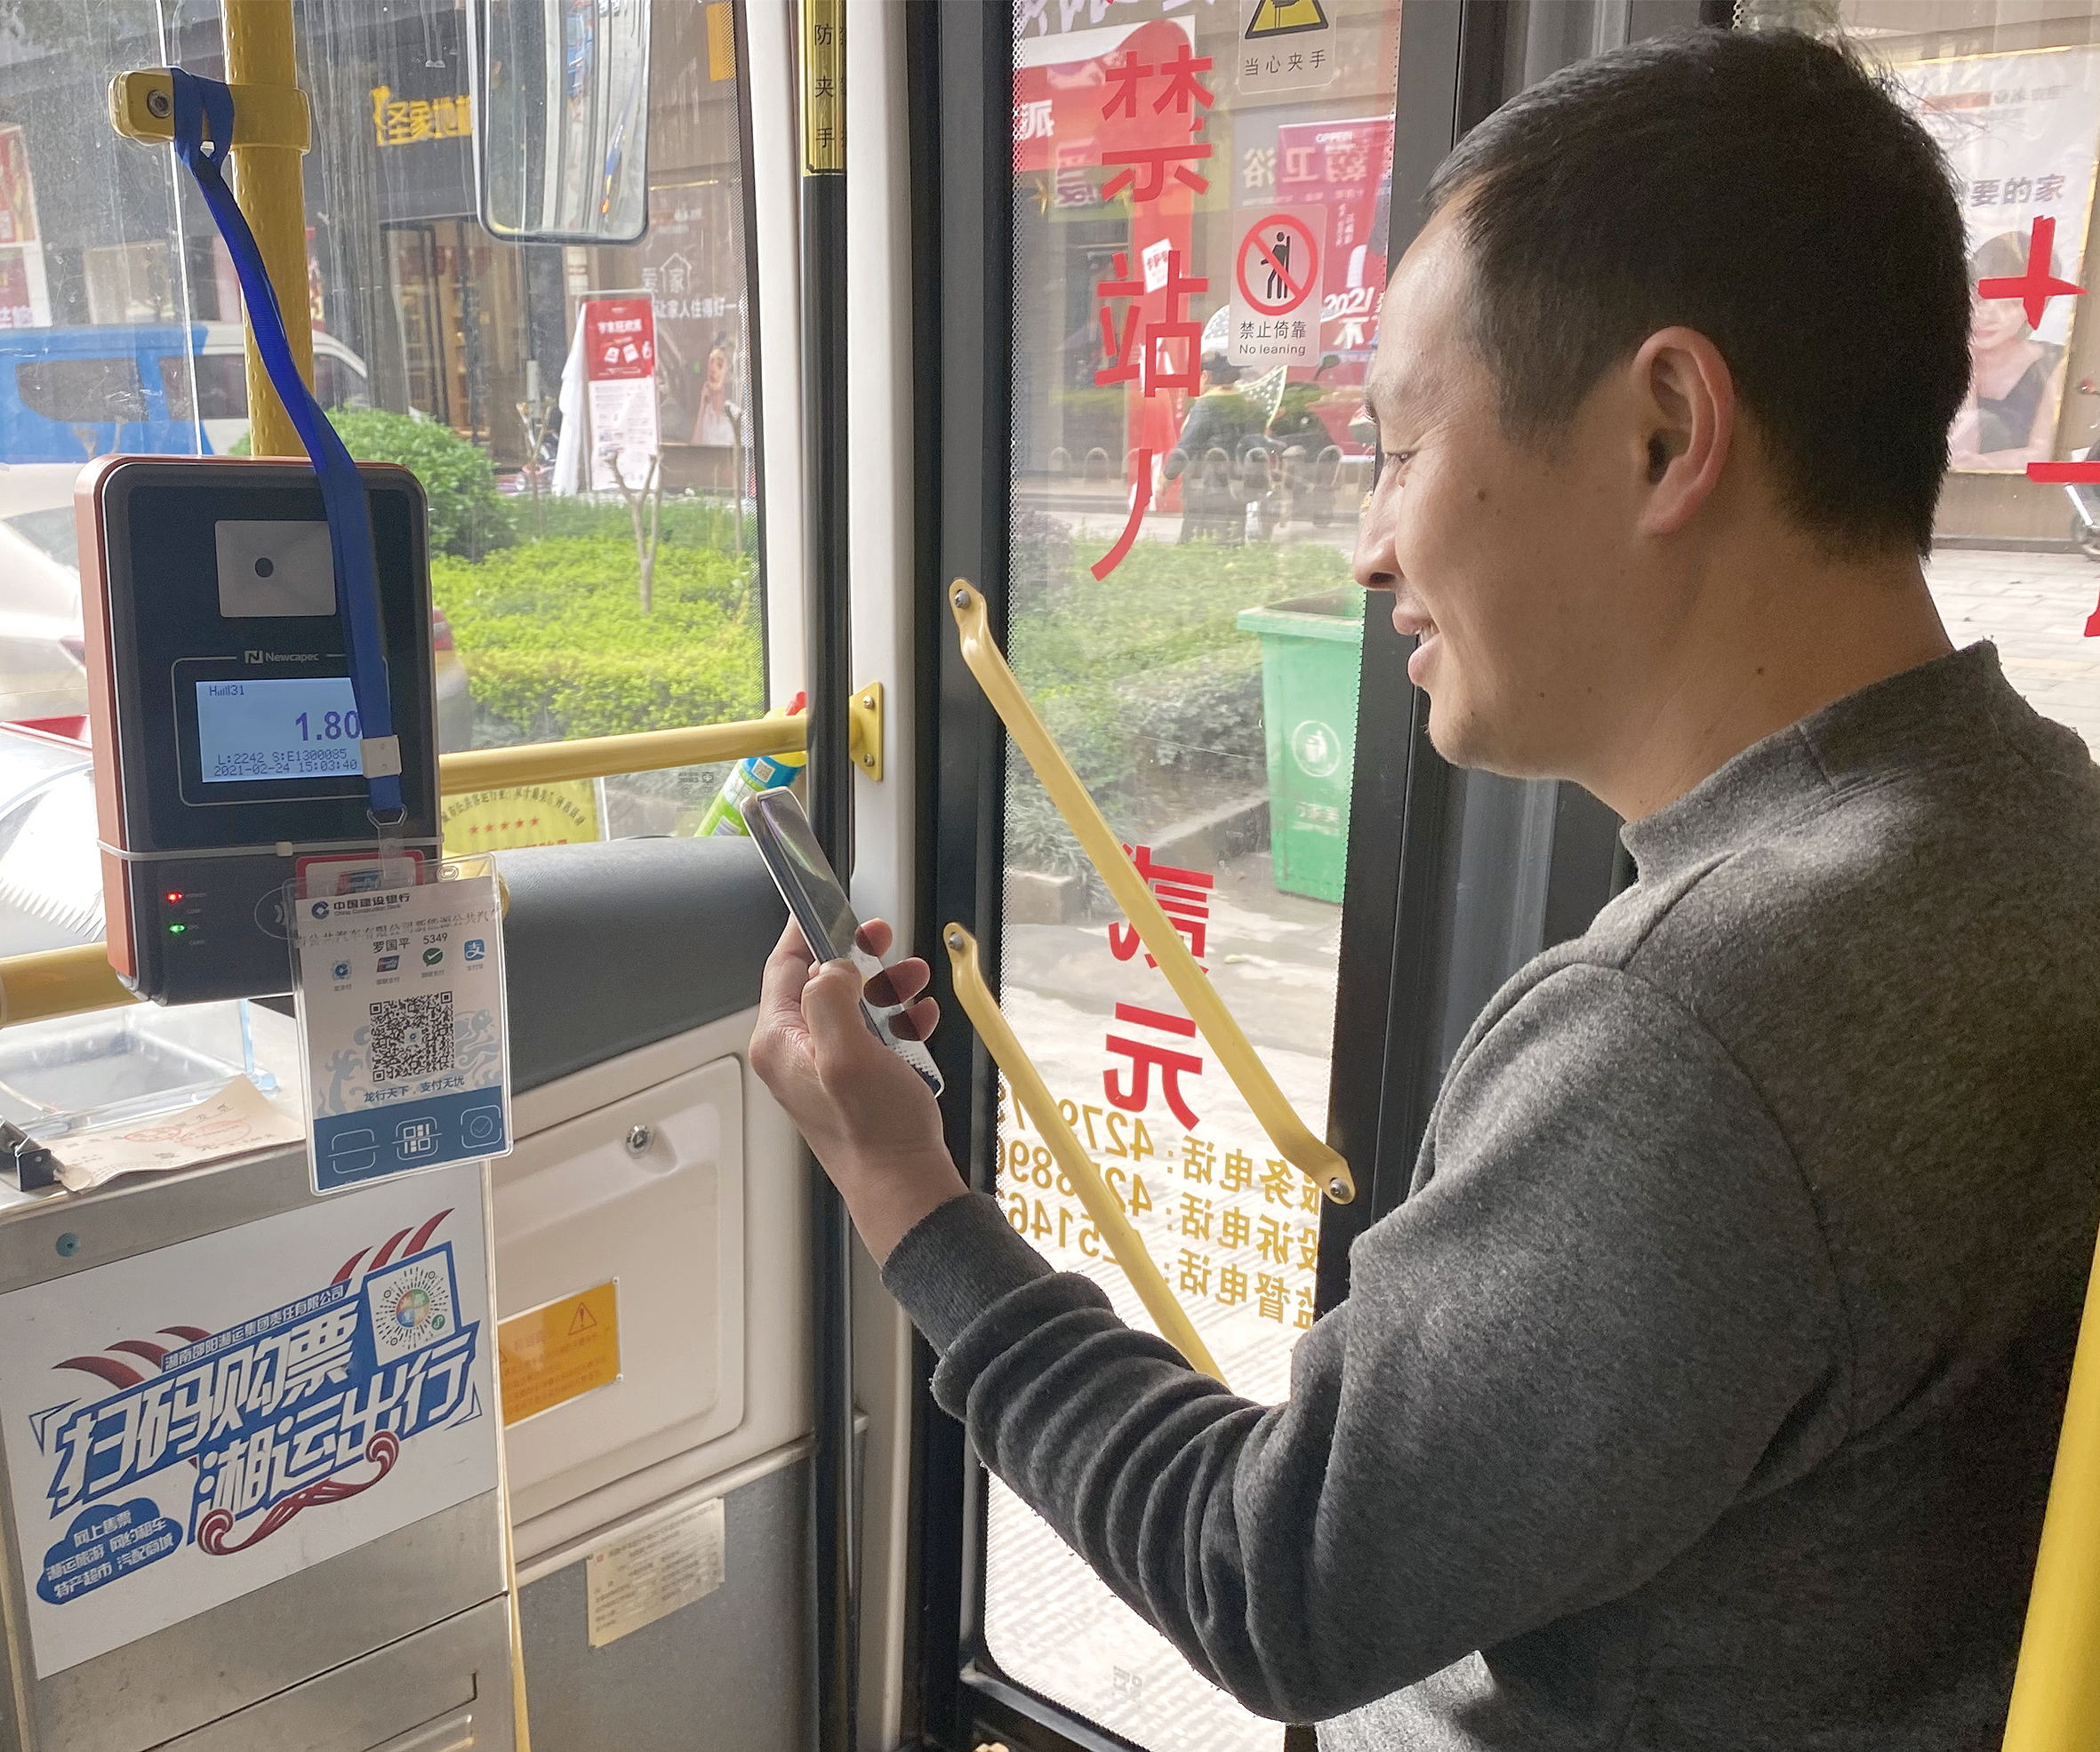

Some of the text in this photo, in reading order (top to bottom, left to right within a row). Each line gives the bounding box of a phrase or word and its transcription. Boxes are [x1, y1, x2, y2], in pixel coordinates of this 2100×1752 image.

[1245, 49, 1326, 76] 当心夹手
[814, 23, 835, 148] 防夹手
[1239, 320, 1307, 340] 禁止倚靠
[1239, 344, 1306, 356] No leaning
[265, 652, 319, 664] Newcapec
[294, 710, 361, 741] 1.80
[213, 759, 357, 777] 2021-02-24 15:03:40
[218, 752, 265, 765] L:2242
[333, 892, 411, 910] 中国建设银行
[372, 933, 448, 953] 罗国平 5349
[54, 1300, 360, 1506] 扫码购票
[199, 1331, 473, 1513] 湘运出行
[74, 1509, 132, 1548] 网上售票
[109, 1519, 166, 1552] 网约租车
[54, 1561, 112, 1598] 特产超市
